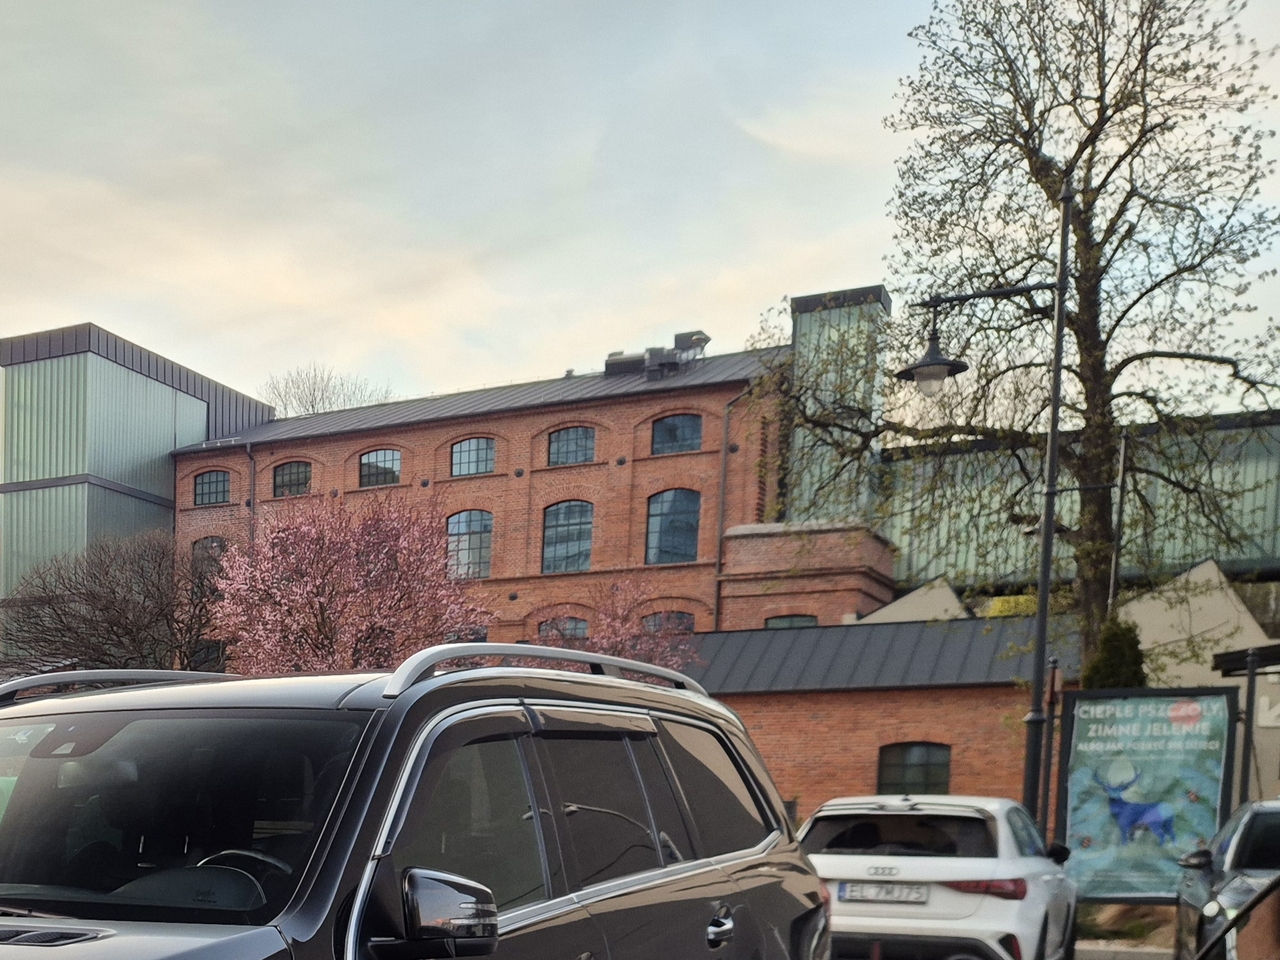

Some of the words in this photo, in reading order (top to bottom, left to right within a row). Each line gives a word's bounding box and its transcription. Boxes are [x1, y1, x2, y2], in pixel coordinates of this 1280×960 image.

[1087, 722, 1141, 738] ZIMNE
[1145, 721, 1211, 737] JELENIE
[849, 884, 868, 899] EL
